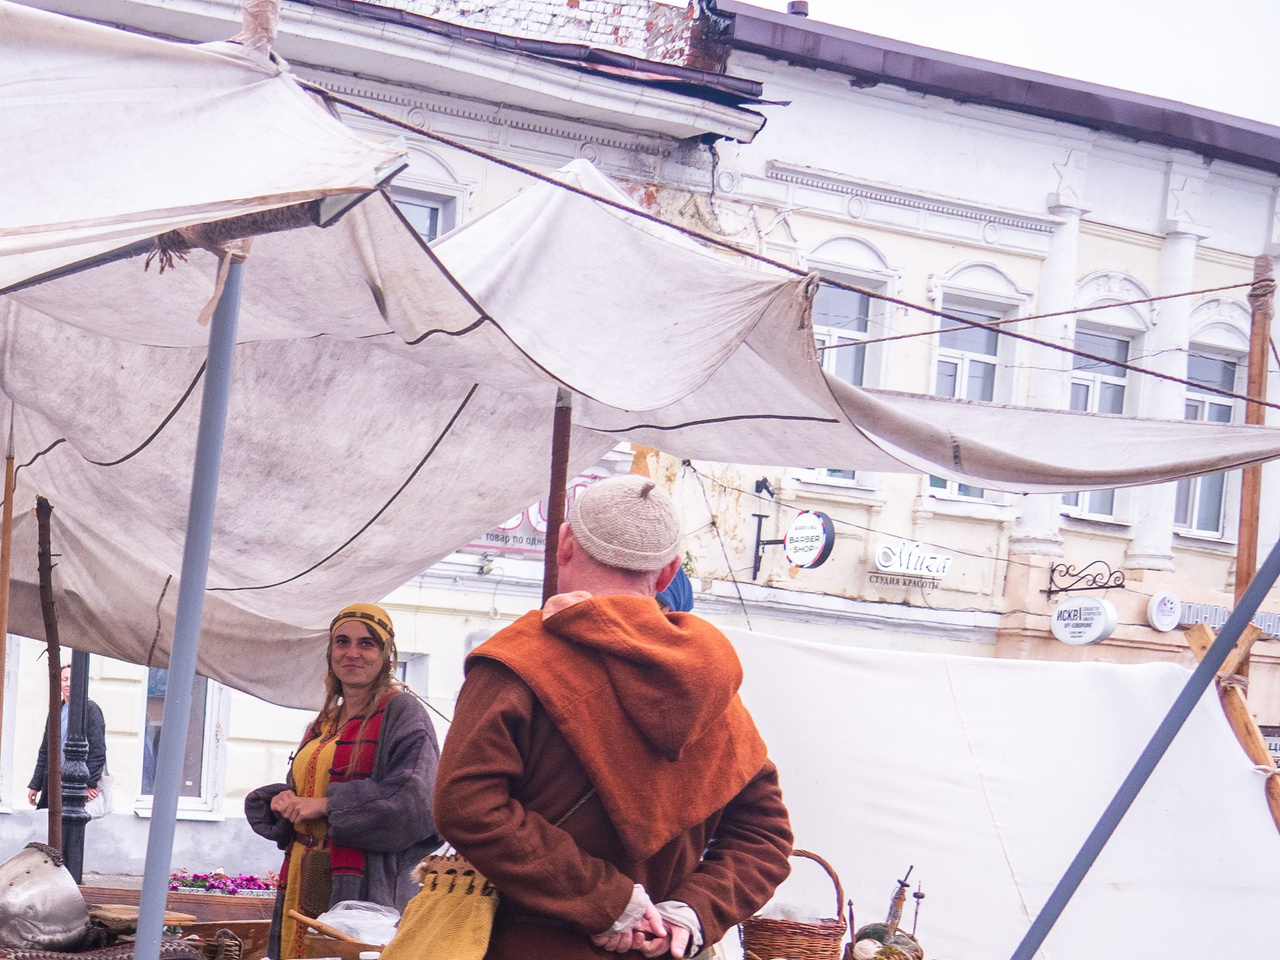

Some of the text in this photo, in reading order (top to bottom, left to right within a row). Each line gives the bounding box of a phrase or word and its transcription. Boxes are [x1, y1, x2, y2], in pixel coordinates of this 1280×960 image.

[485, 532, 510, 546] товар
[512, 536, 524, 544] по
[788, 535, 821, 544] BARBER
[793, 545, 815, 553] SHOP
[869, 574, 939, 590] СТУДИЯ КРАСОТЫ
